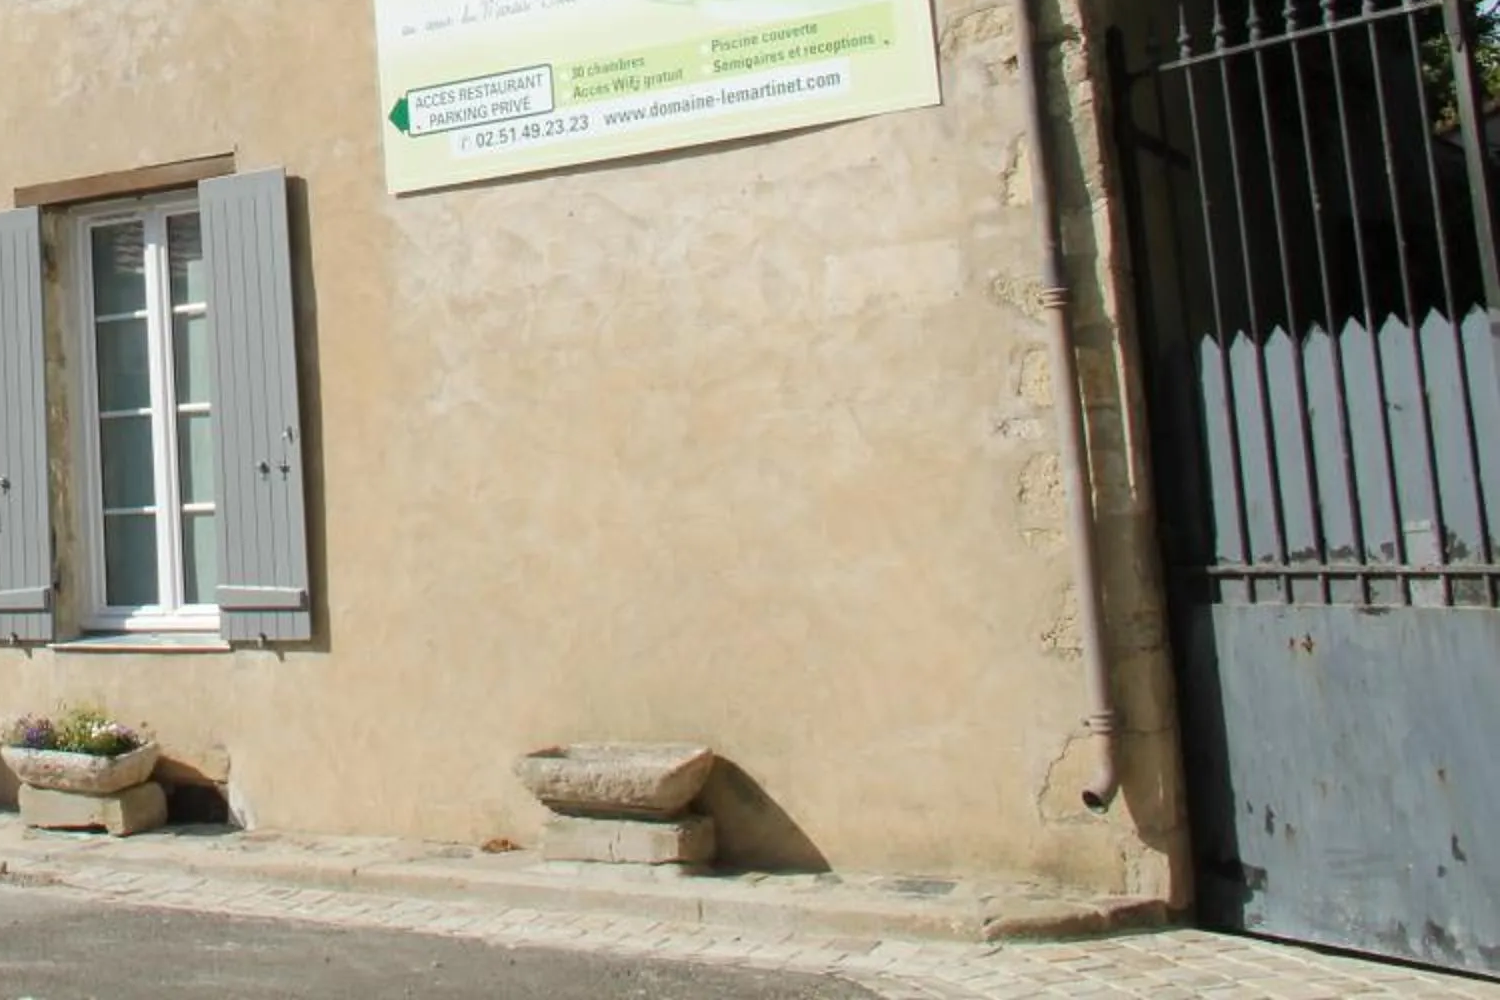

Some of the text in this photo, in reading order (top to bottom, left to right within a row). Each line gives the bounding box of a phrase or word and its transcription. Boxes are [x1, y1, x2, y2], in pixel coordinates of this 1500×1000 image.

[711, 23, 818, 52] Piscine couverte
[788, 46, 802, 60] et
[587, 56, 646, 78] chambres
[459, 73, 543, 102] RESTAURANT
[603, 69, 842, 127] www.domaine-lemartinet.com
[429, 104, 488, 128] PARKING
